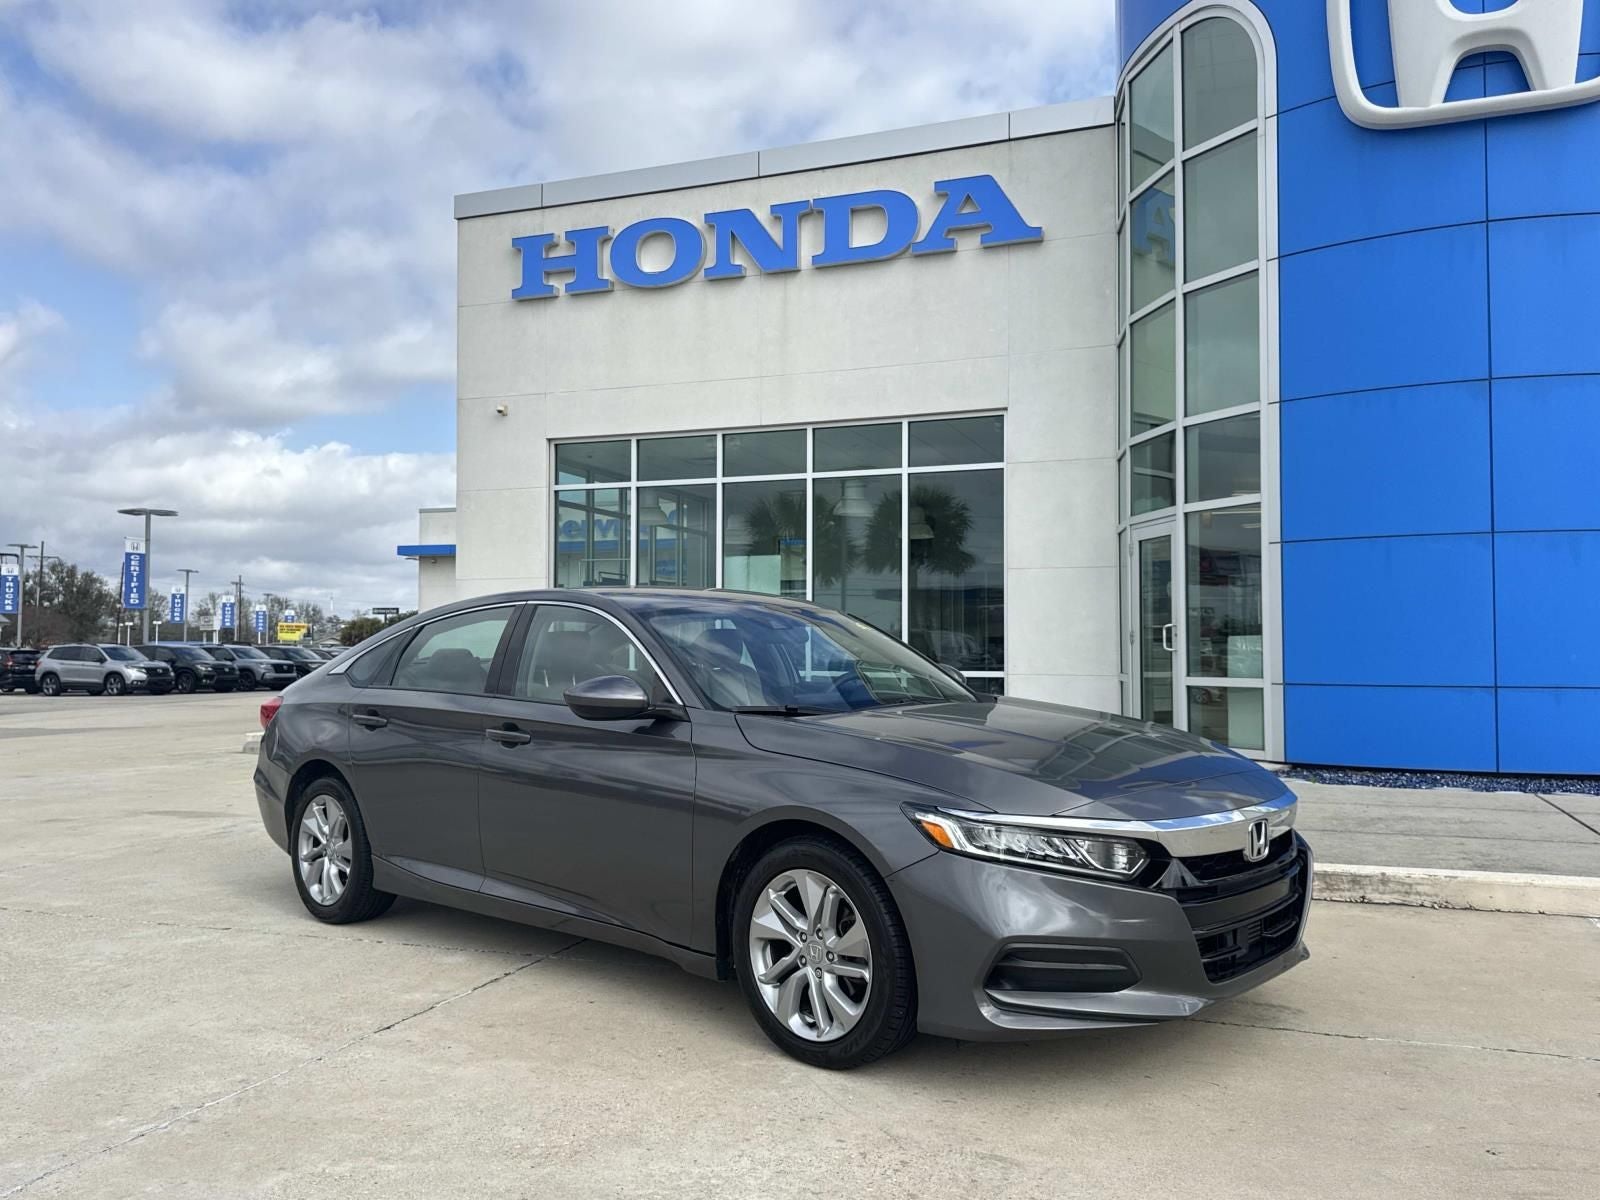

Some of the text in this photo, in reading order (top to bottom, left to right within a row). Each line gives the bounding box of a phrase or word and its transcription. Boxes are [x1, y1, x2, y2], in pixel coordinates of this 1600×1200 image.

[511, 174, 1044, 301] HONDA
[4, 576, 14, 611] TRUCKS
[129, 554, 140, 605] CERTIFIED
[173, 594, 181, 622] TRUCKS
